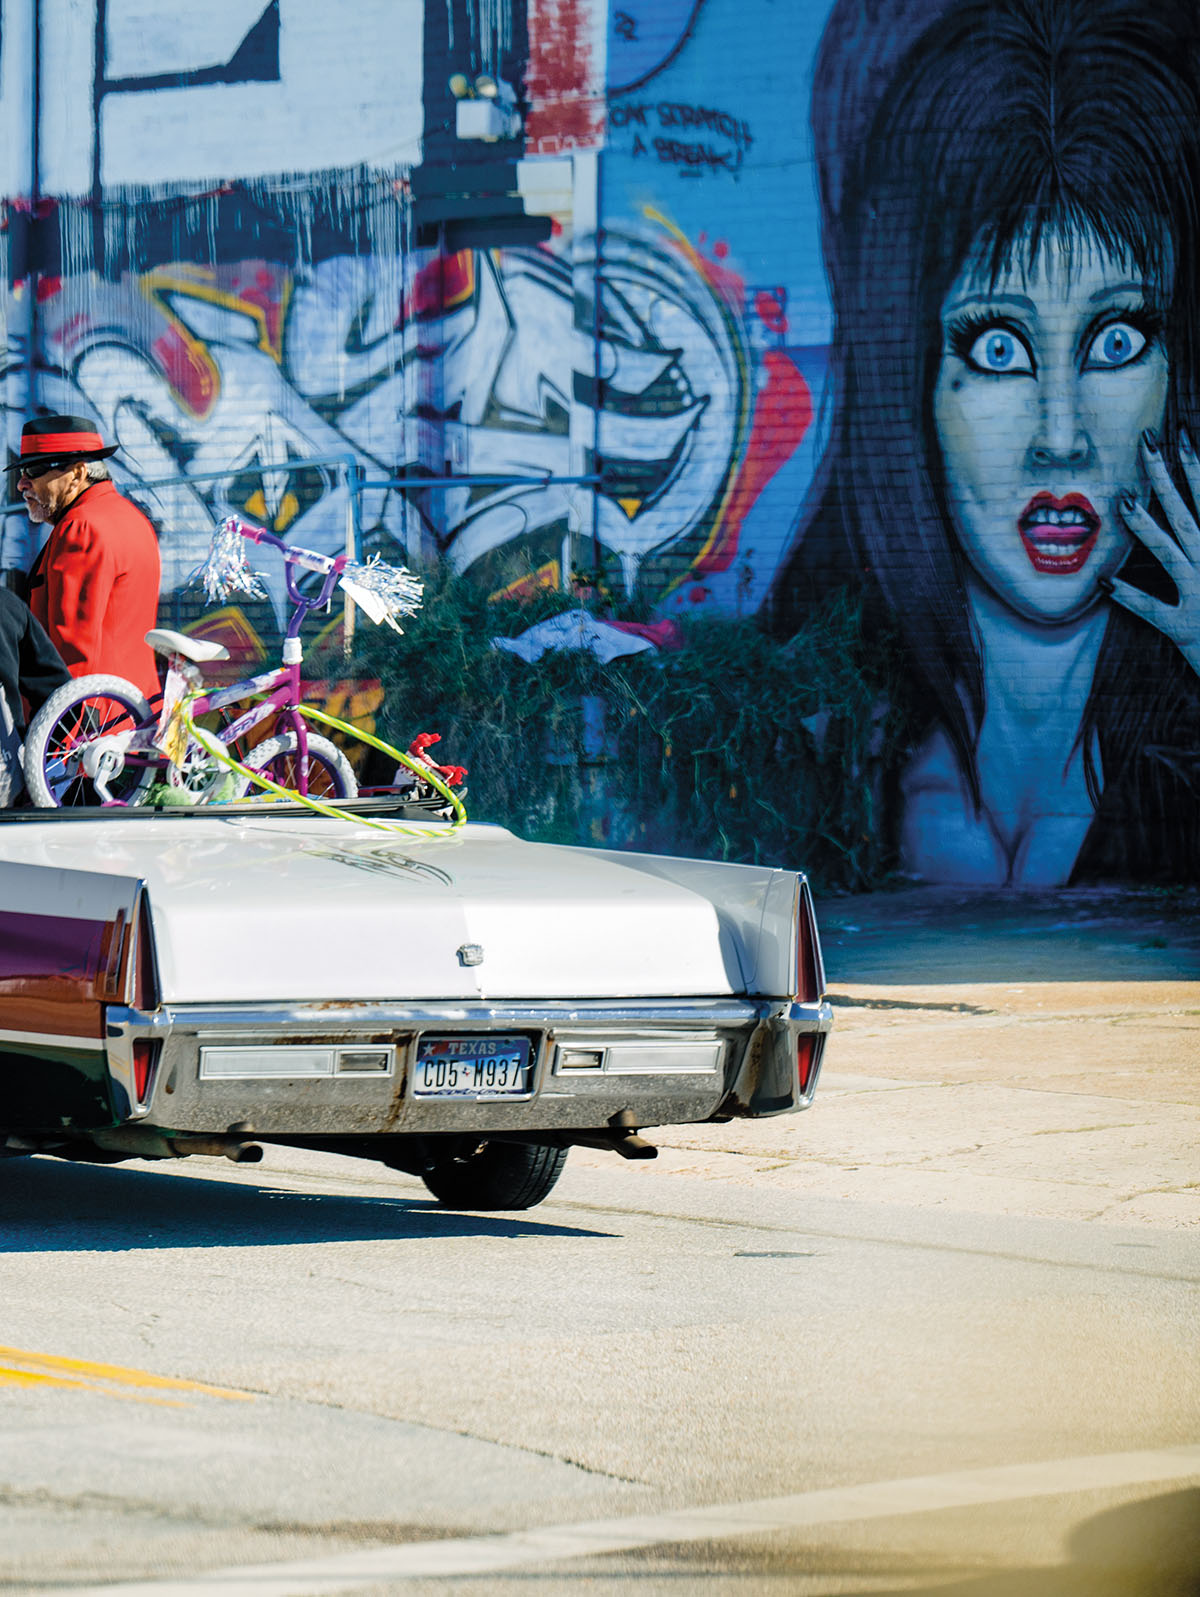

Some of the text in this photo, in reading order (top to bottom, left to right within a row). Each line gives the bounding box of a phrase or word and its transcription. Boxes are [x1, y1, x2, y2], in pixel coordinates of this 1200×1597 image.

[632, 134, 648, 157] A
[449, 1042, 497, 1055] TEXAS
[424, 1059, 521, 1087] CD5 M937
